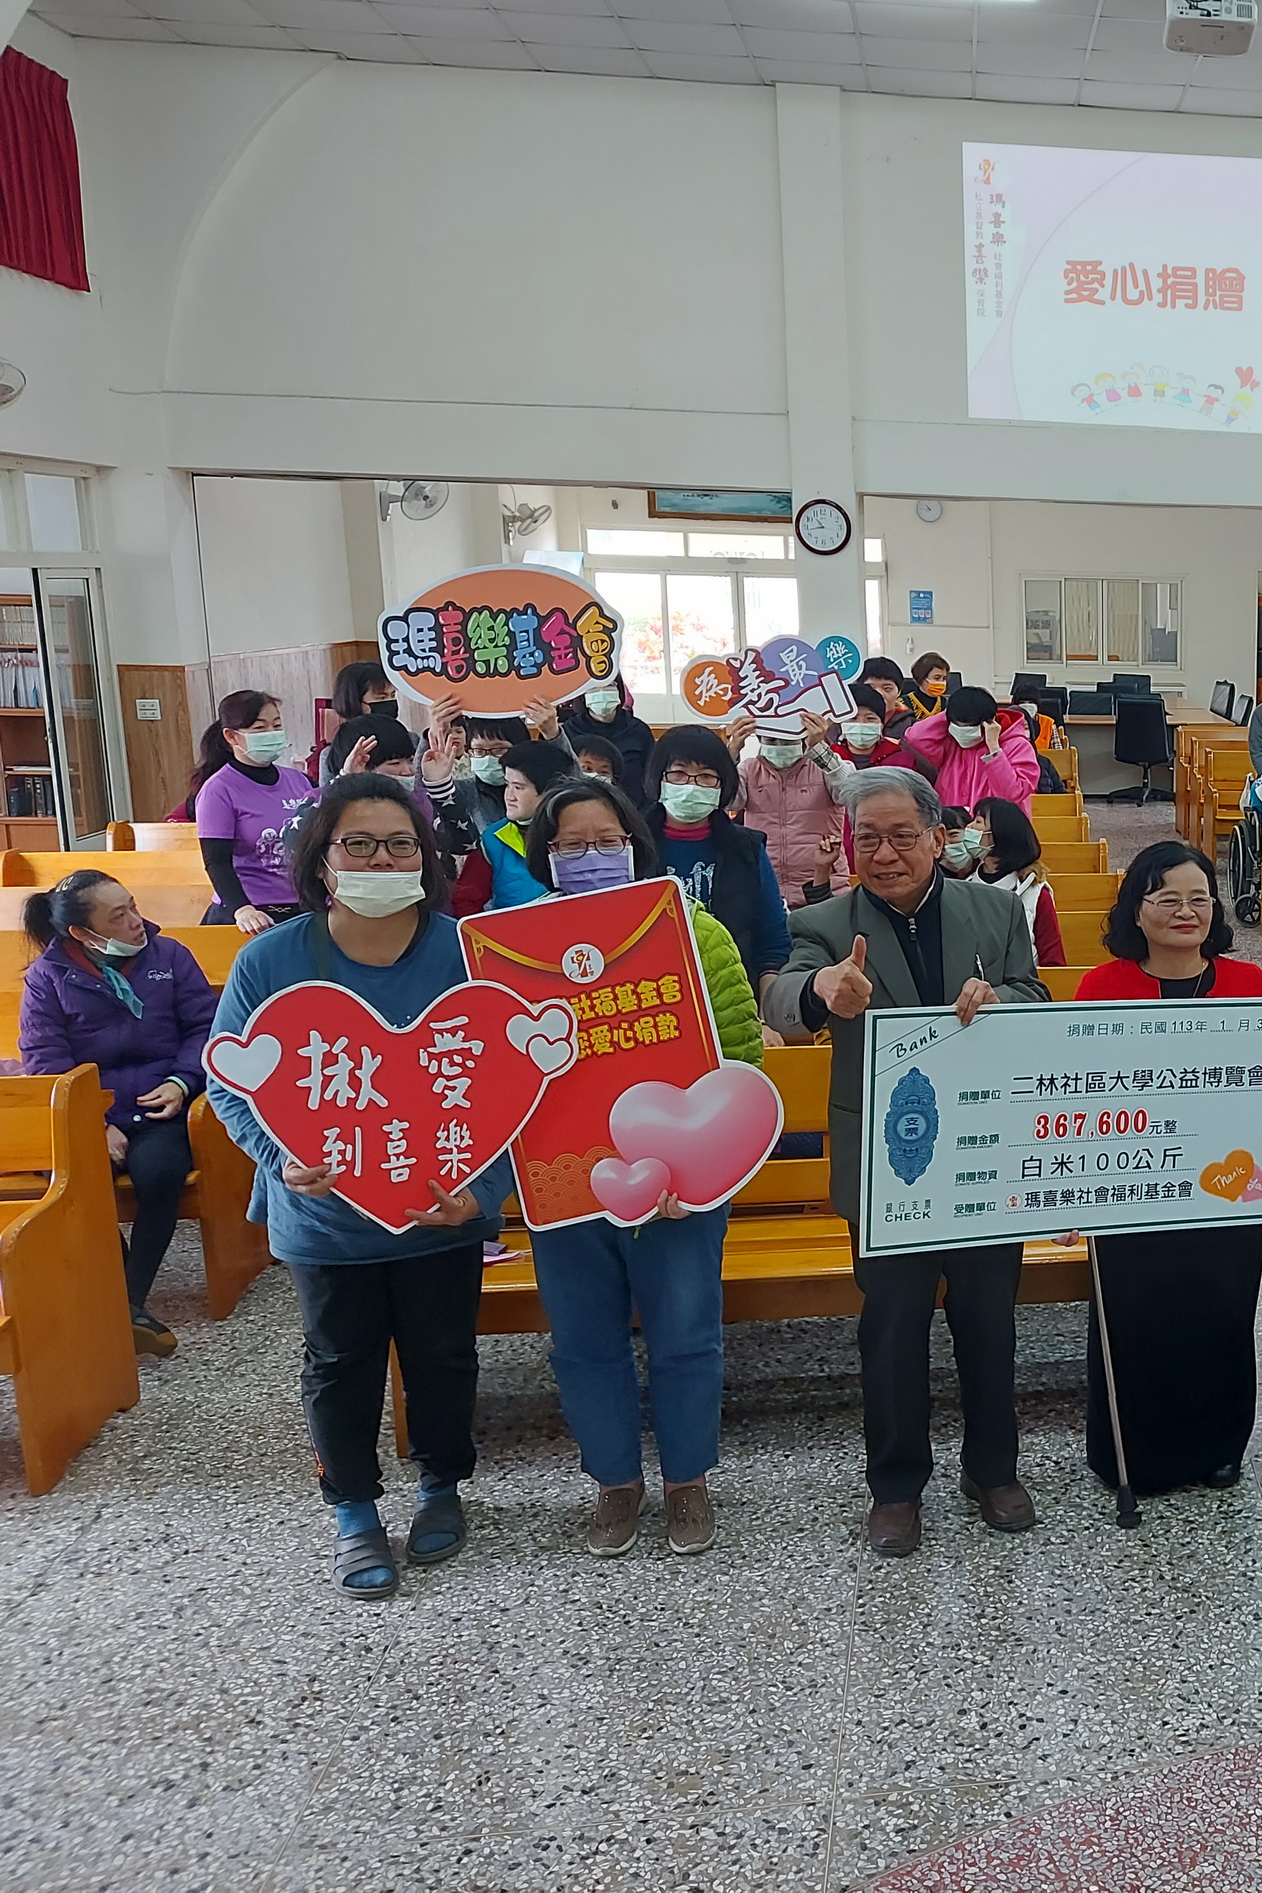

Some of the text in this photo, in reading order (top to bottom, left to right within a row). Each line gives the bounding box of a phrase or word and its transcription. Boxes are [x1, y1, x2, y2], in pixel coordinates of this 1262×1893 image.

[1063, 260, 1246, 312] 愛心捐贈
[386, 603, 615, 679] 瑪喜樂基金會
[694, 641, 853, 716] 為善最樂
[888, 1025, 940, 1059] Bank
[296, 1016, 485, 1110] 揪愛
[958, 1089, 1002, 1102] 捐贈單位
[321, 1118, 474, 1183] 到喜樂
[956, 1133, 1000, 1147] 捐贈金額
[955, 1169, 998, 1183] 捐贈物資
[1020, 1146, 1184, 1179] 白米100公斤
[1211, 1166, 1246, 1190] Thank
[953, 1201, 998, 1215] 受贈單位
[1024, 1180, 1194, 1210] 瑪喜樂社會福利基金會
[884, 1211, 932, 1223] CHECK
